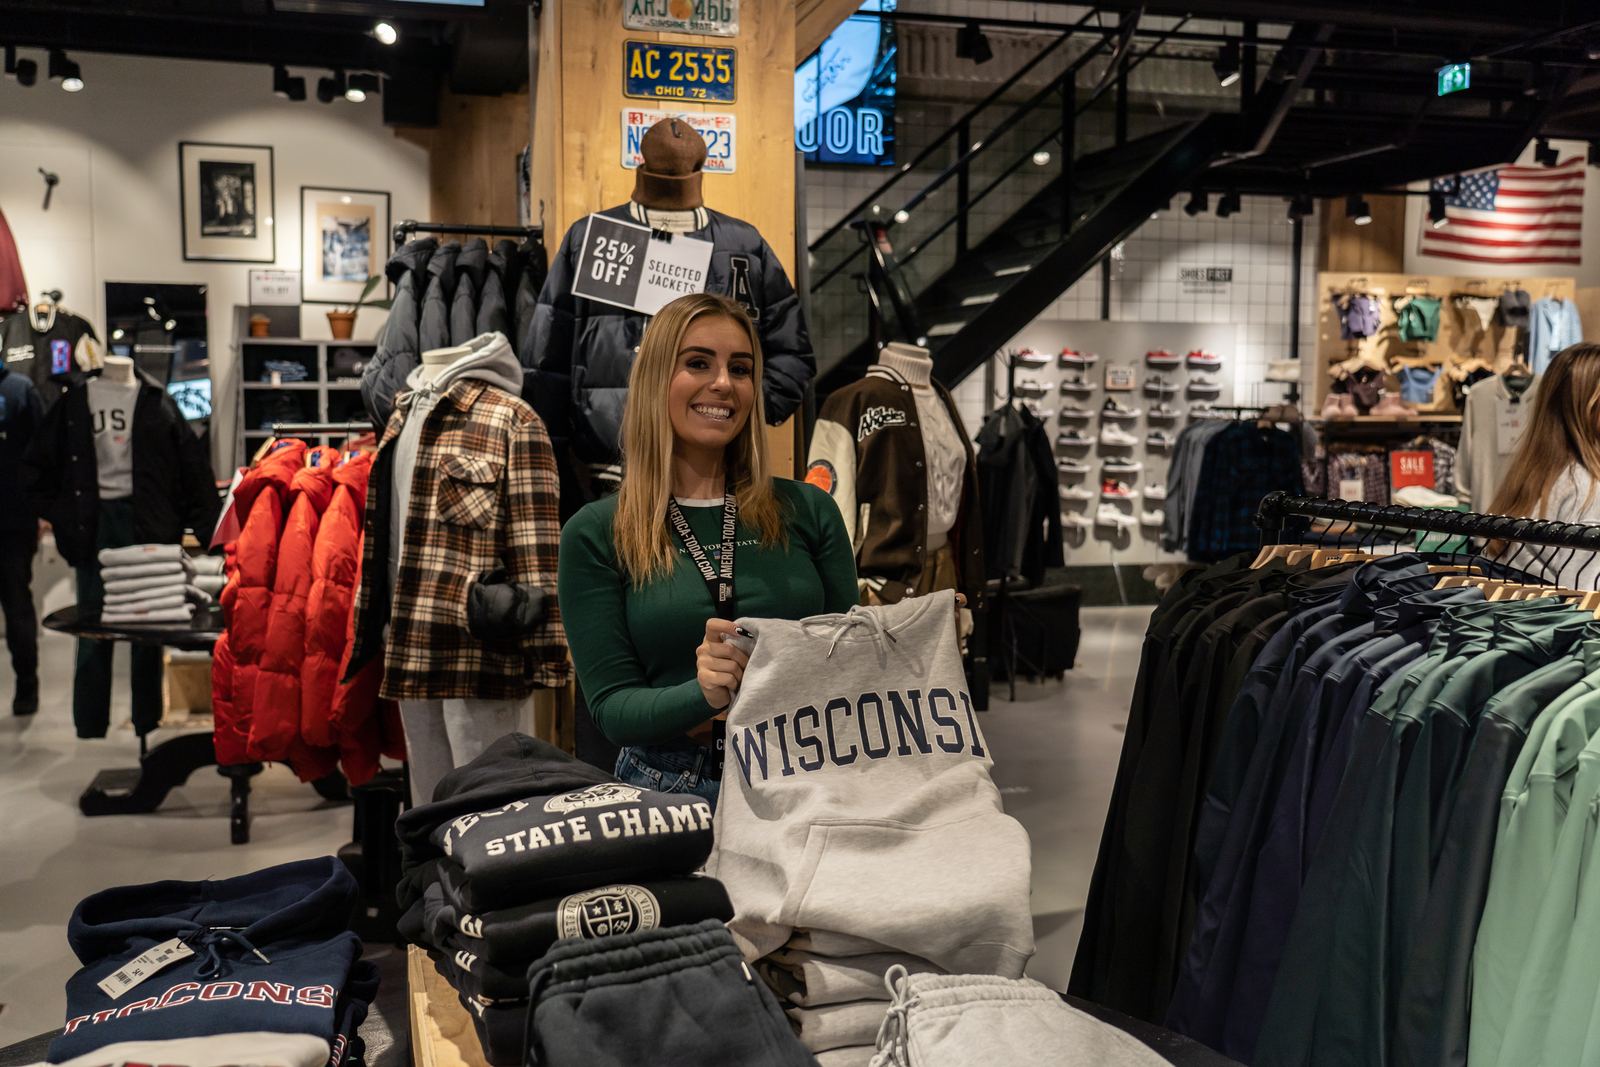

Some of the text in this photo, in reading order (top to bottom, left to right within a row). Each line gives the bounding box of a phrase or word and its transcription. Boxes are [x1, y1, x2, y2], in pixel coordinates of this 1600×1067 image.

[630, 49, 731, 84] AC 2535
[655, 85, 707, 98] OHIO 72
[592, 236, 635, 266] 25%
[590, 259, 630, 286] OFF
[648, 259, 702, 282] SELECTED
[648, 274, 696, 294] JACKETS
[730, 257, 760, 321] A
[1400, 456, 1424, 470] SALE
[485, 815, 592, 856] STATE
[598, 802, 712, 839] CHAMP
